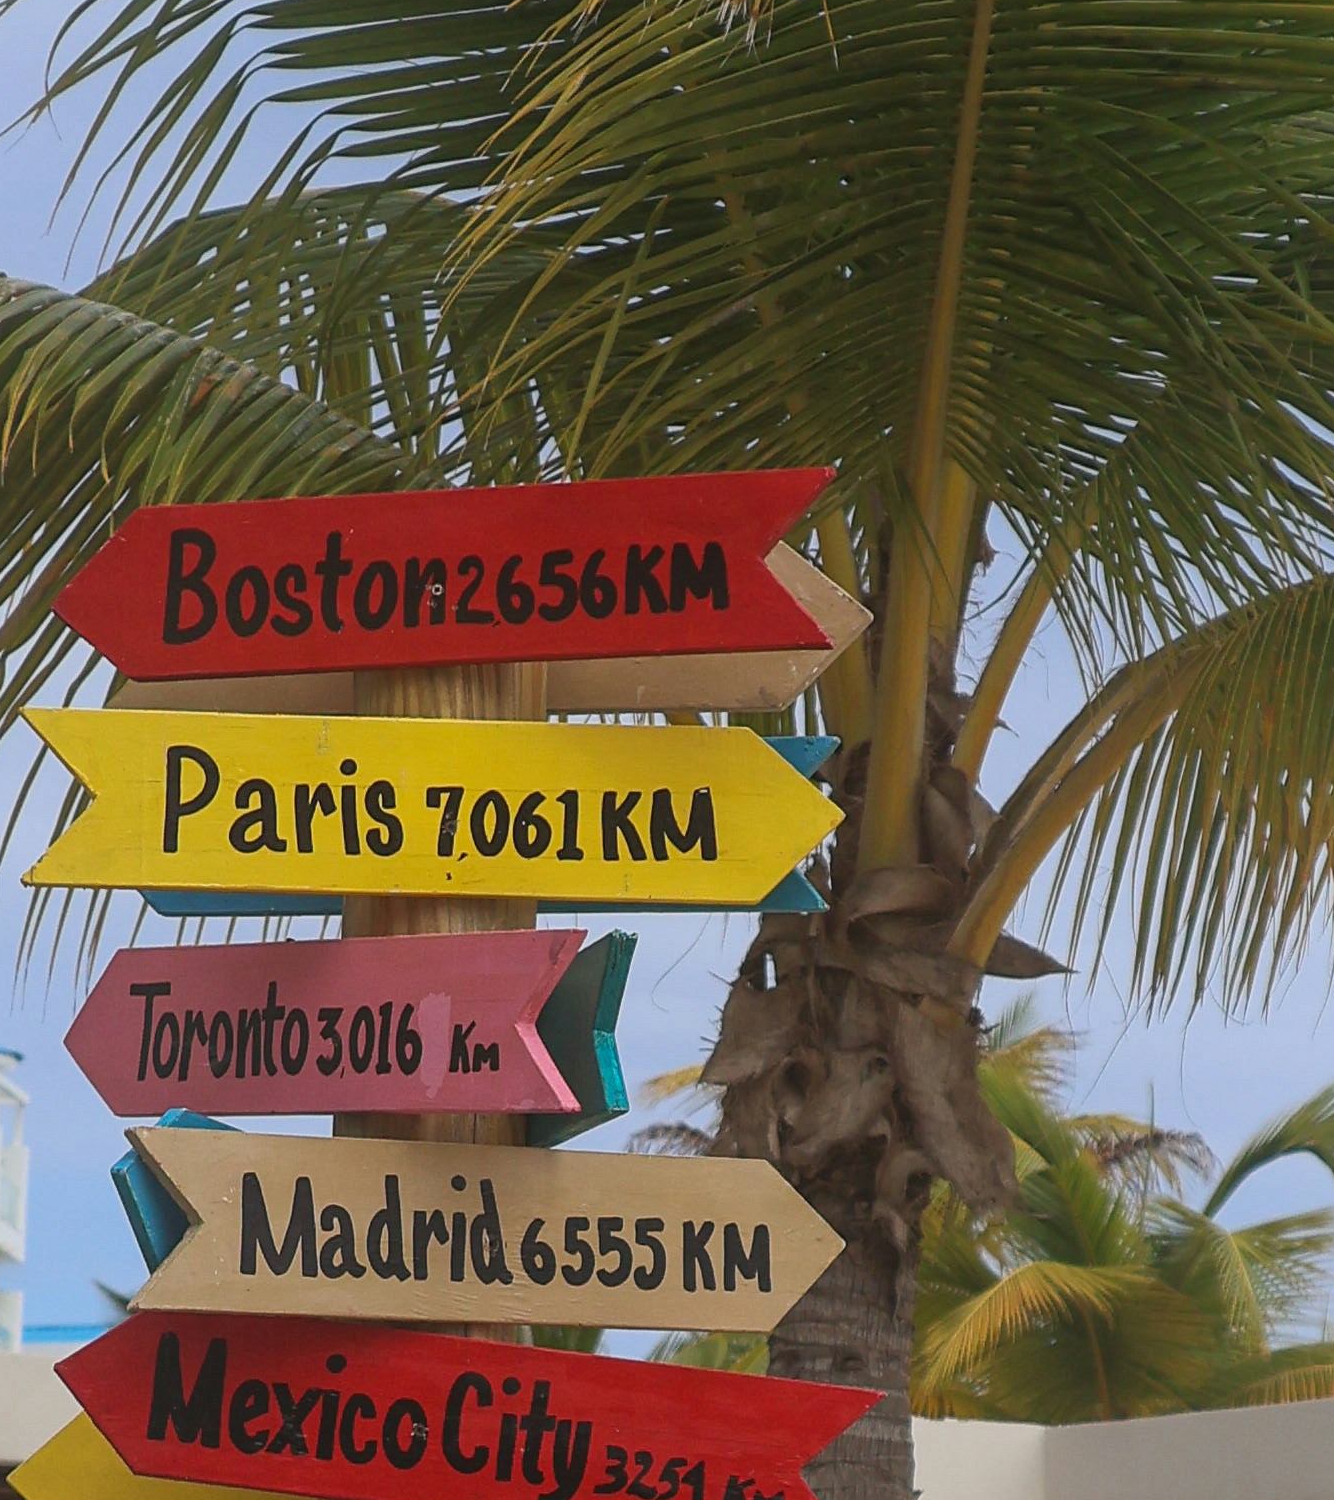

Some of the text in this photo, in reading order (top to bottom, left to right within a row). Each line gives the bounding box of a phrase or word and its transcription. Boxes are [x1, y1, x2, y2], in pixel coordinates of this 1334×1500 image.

[163, 529, 447, 645] Boston
[625, 542, 729, 615] KM
[163, 746, 403, 856] Paris
[602, 787, 717, 861] KM
[130, 981, 309, 1081] Toronto
[240, 1172, 771, 1292] Madrid 6555 KM
[147, 1331, 425, 1469] Mexico
